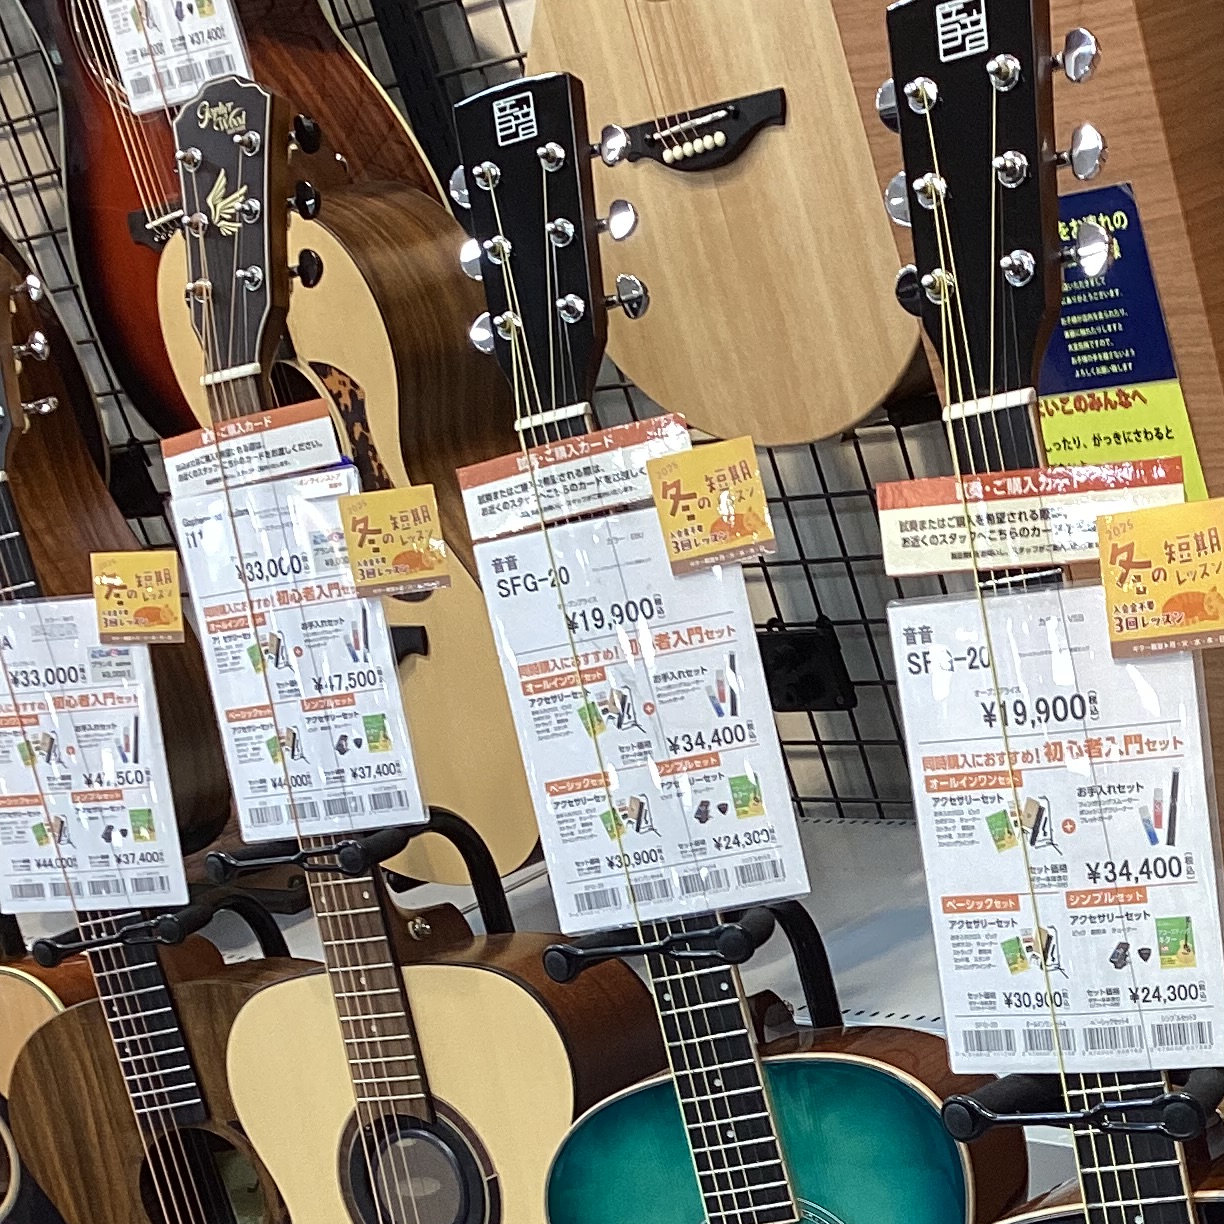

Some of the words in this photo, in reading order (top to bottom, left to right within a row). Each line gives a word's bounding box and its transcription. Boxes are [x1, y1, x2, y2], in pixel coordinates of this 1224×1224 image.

[1163, 526, 1222, 565] 短期
[496, 565, 571, 600] SFG-20
[565, 596, 656, 635] ¥19,900
[902, 624, 934, 646] 音音
[906, 645, 993, 675] SF-20
[9, 665, 79, 688] ¥33,000
[980, 693, 1088, 728] ¥19,900
[666, 723, 747, 755] ¥34,400
[350, 761, 397, 780] ¥37,400
[931, 793, 1005, 808] アクセサリーセット
[1076, 781, 1145, 798] お手入れセット
[1085, 855, 1183, 885] ¥34,400
[945, 898, 1016, 911] ベーシックセット
[1068, 891, 1145, 906] シンプルセット
[948, 917, 1019, 930] アクセサリーセット
[1069, 910, 1151, 926] アクセサリーセット
[1002, 990, 1063, 1011] ¥30,900
[1128, 983, 1199, 1005] ¥24,300
